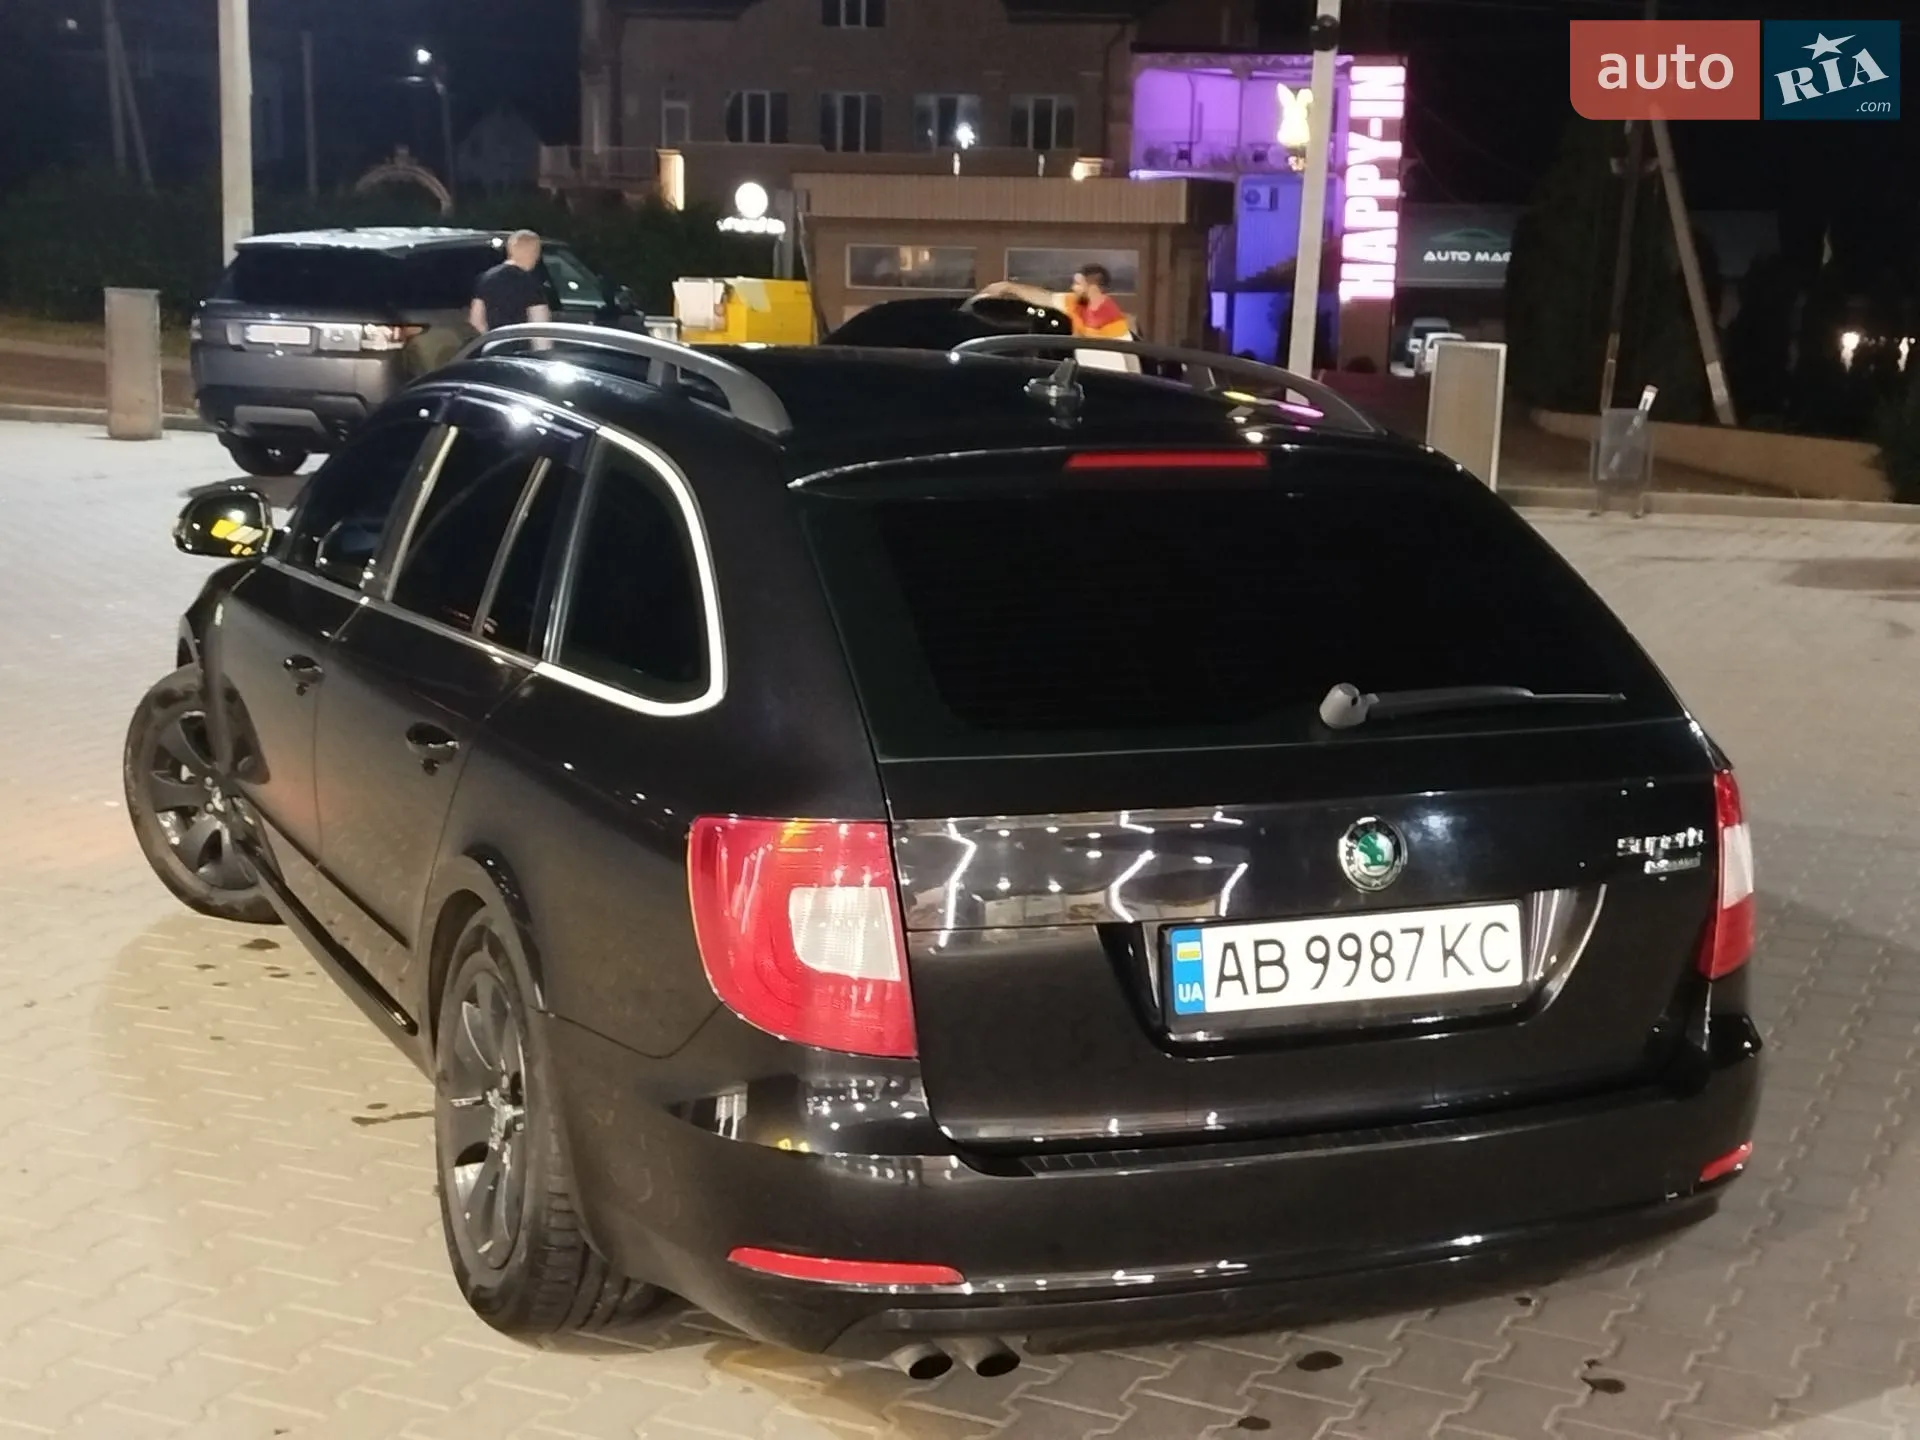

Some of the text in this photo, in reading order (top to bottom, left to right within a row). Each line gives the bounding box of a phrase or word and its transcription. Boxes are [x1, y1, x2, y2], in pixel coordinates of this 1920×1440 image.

[1339, 66, 1406, 302] HAPPY-IN
[1423, 250, 1471, 262] AUTO
[1214, 921, 1511, 999] AB 9987 KC
[1178, 982, 1204, 1003] UA
